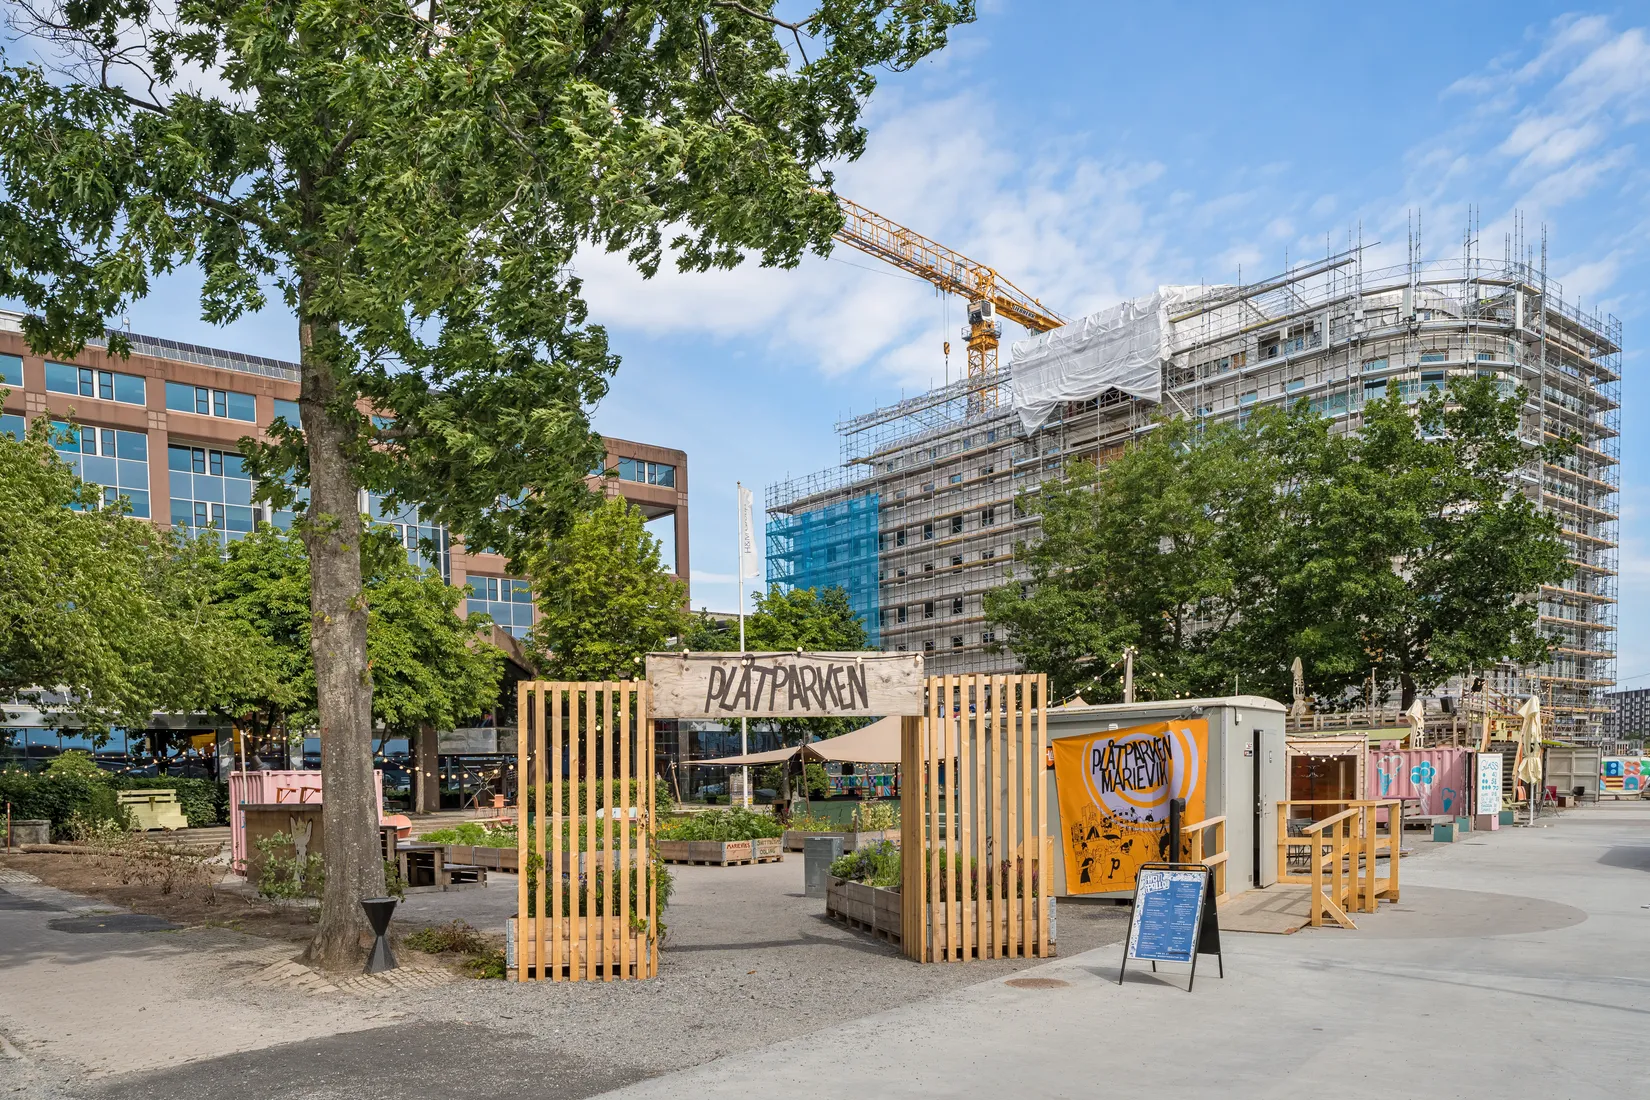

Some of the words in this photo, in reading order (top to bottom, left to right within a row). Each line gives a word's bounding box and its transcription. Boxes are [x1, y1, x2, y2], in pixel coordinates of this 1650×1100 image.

[704, 653, 869, 713] PLÅTPARKEN
[1092, 735, 1173, 774] PLÅTPARKEN
[1481, 760, 1498, 771] GLASS
[1101, 762, 1169, 794] MARIEVIK
